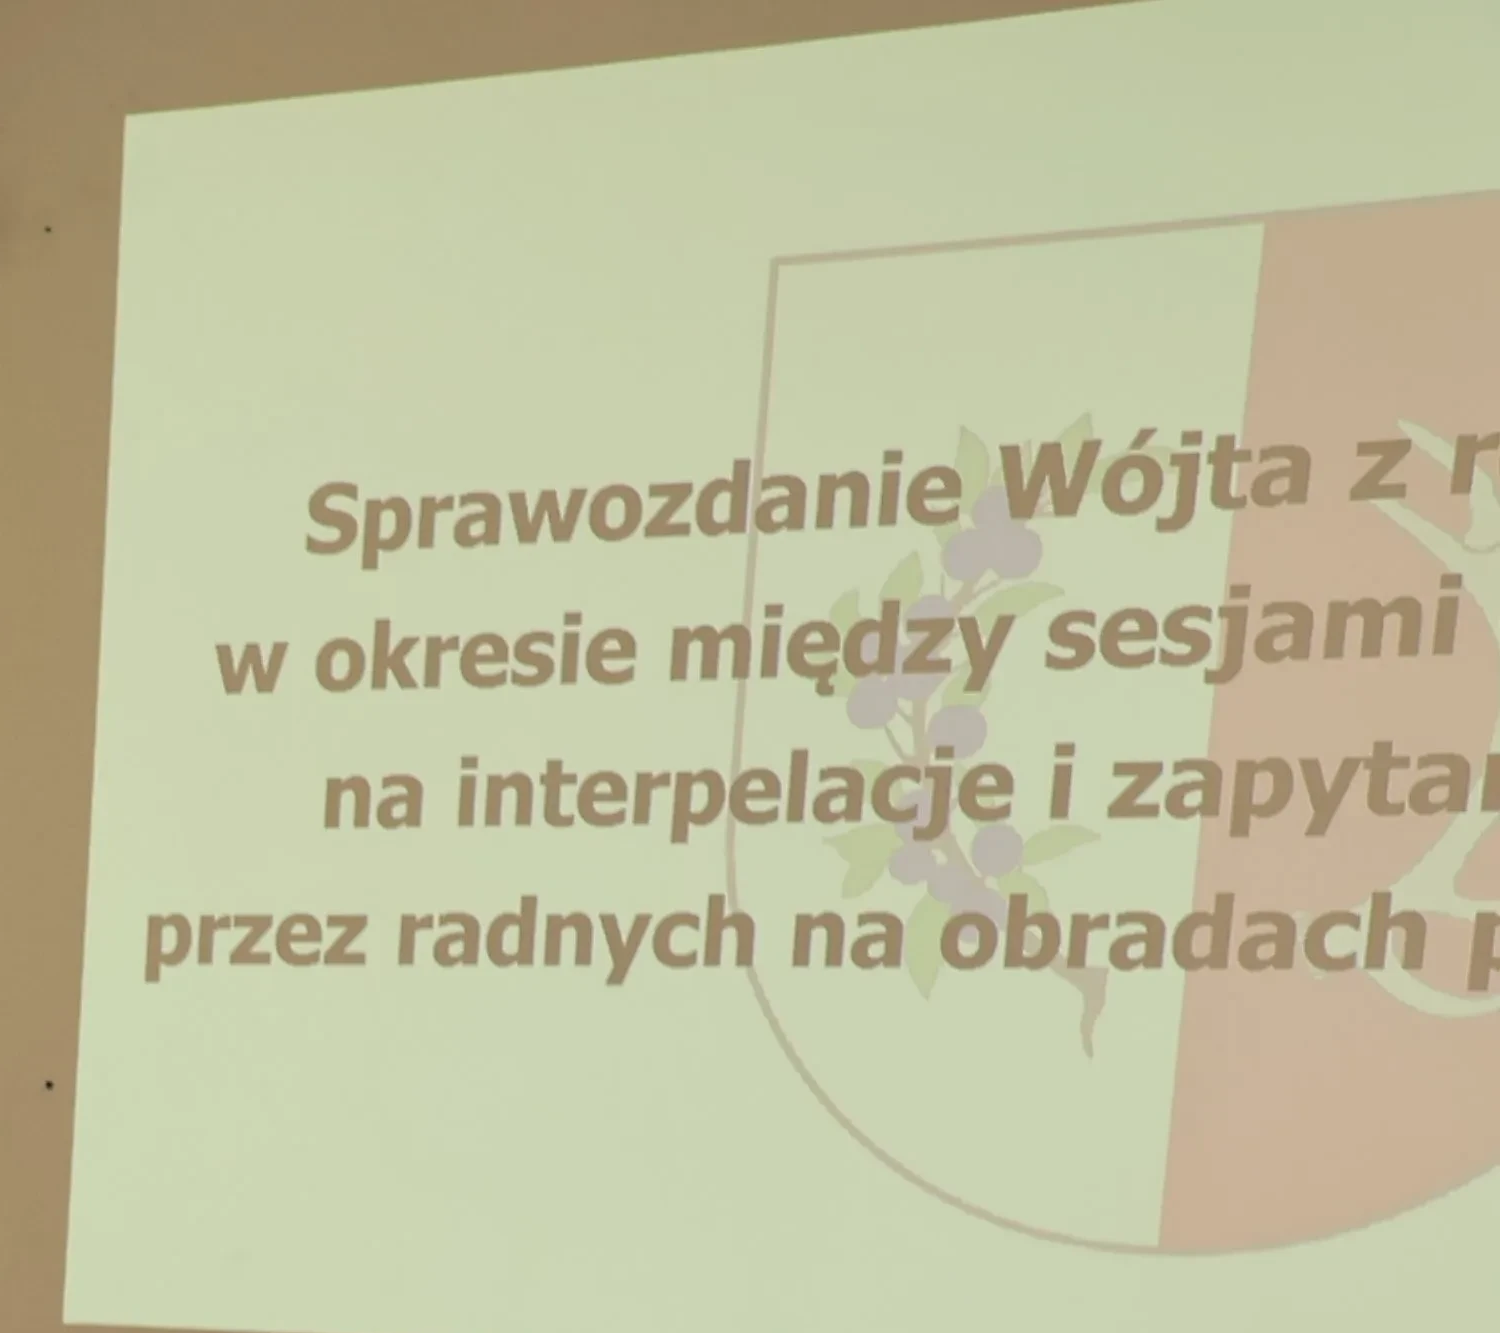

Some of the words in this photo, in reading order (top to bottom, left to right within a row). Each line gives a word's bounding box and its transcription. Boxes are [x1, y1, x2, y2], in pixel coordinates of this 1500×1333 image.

[307, 451, 961, 568] Sprawozdanie
[1000, 429, 1311, 531] Wójta
[1351, 439, 1411, 500] z
[217, 644, 286, 692] w
[317, 614, 635, 691] okresie
[671, 601, 1014, 695] między
[1047, 574, 1461, 683] sesjami
[326, 776, 422, 827] na
[459, 747, 1013, 842] interpelacje
[1051, 744, 1074, 817] i
[147, 915, 366, 981] przez
[400, 895, 754, 984] radnych
[794, 913, 902, 968] na
[941, 892, 1426, 970] obradach
